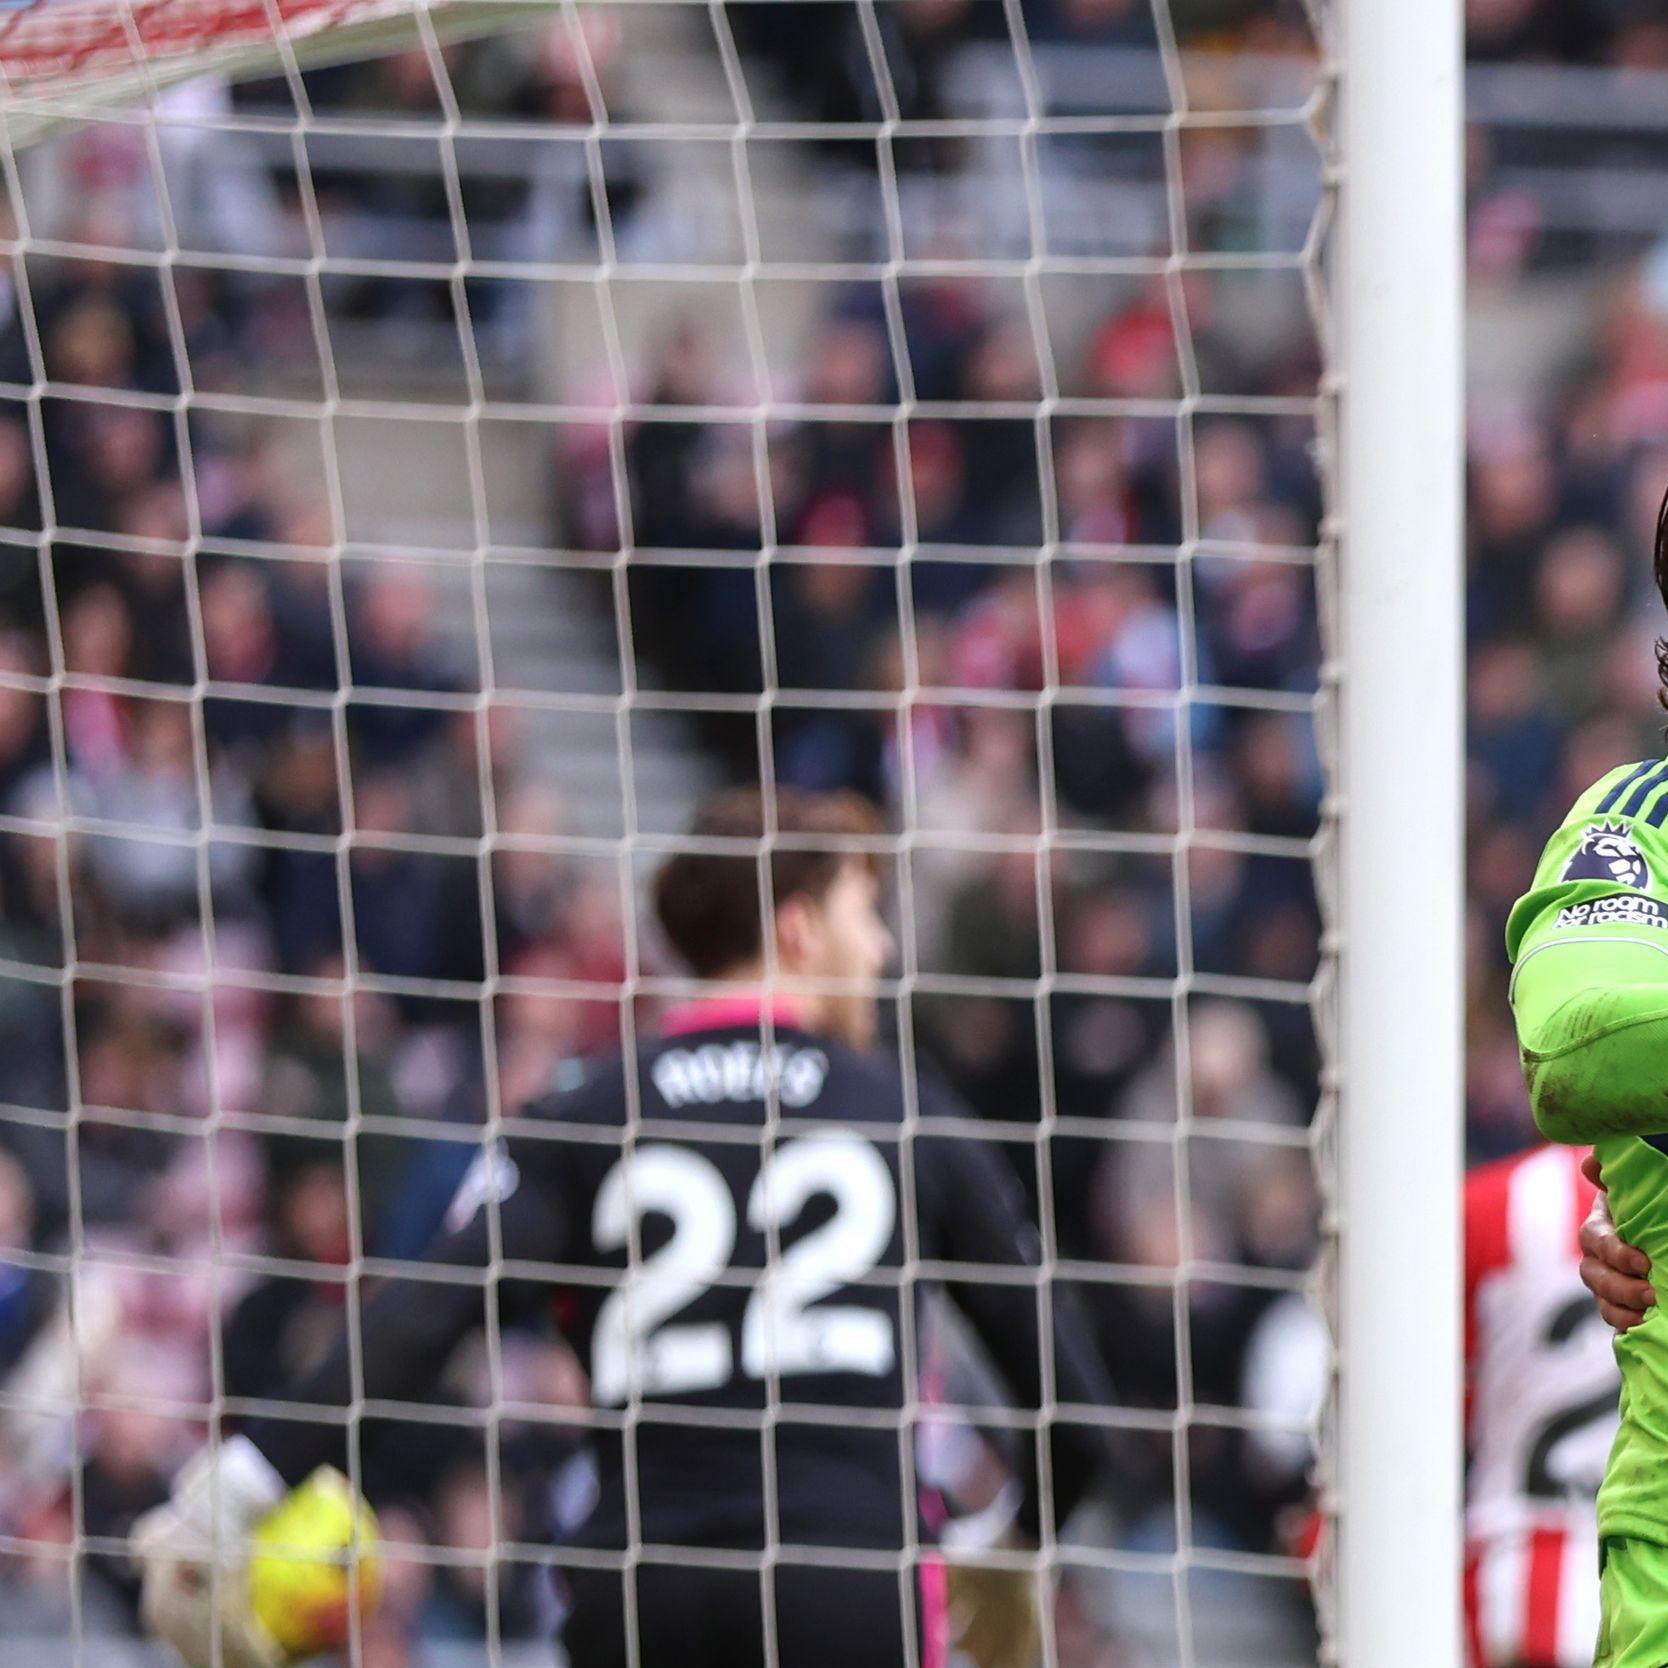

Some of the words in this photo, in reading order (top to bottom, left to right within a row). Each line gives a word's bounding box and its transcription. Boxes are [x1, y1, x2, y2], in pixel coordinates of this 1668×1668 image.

[1560, 904, 1591, 920] No
[1592, 896, 1659, 915] room
[1588, 911, 1668, 929] racism
[591, 1127, 896, 1400] 22
